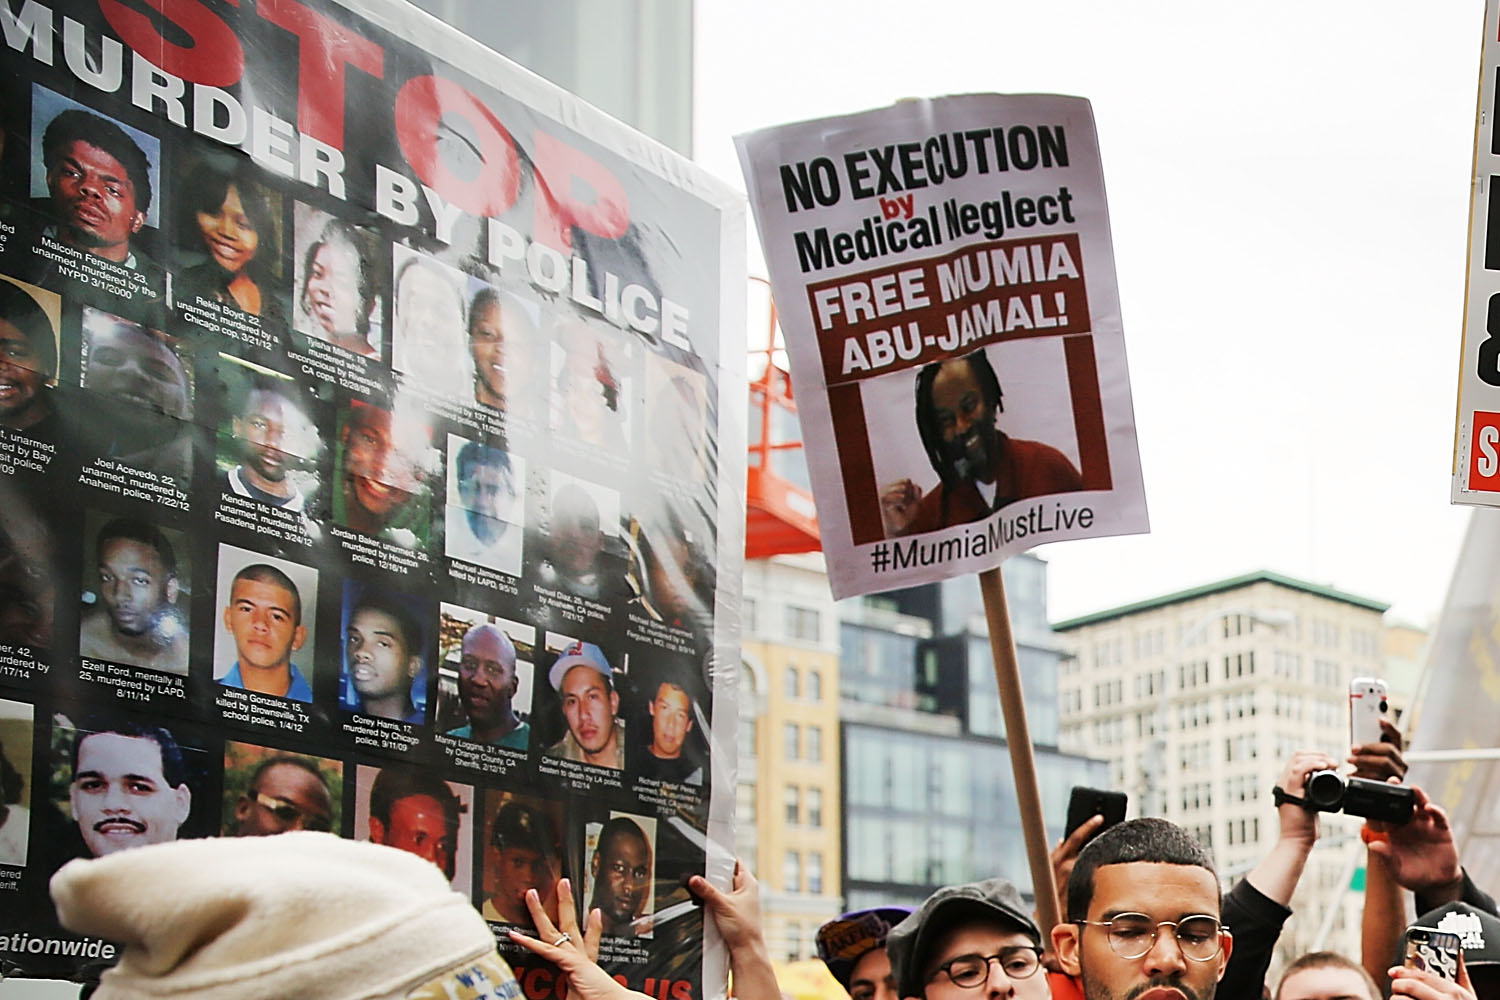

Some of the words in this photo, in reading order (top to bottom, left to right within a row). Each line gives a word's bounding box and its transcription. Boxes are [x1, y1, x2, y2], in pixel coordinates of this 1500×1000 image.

[100, 0, 629, 255] STOP
[0, 0, 346, 200] MURDER
[376, 164, 452, 245] BY
[488, 217, 691, 351] POLICE
[780, 157, 841, 212] NO
[844, 124, 1070, 201] EXECUTION
[879, 194, 915, 221] by
[794, 206, 942, 272] Medical
[947, 187, 1075, 241] Neglect
[42, 237, 83, 259] Malcolm
[59, 265, 89, 283] NYPD
[91, 277, 132, 299] 3/1/2000
[82, 264, 126, 287] murdered
[128, 283, 139, 294] by
[142, 286, 156, 298] the
[815, 268, 930, 330] FREE
[937, 242, 1079, 302] MUMIA
[842, 293, 1068, 375] ABU-JAMAL!
[17, 446, 30, 458] by
[32, 450, 51, 464] Bay
[94, 458, 114, 470] Joel
[78, 475, 120, 494] Anaheim
[156, 495, 190, 512] 7/22/12
[130, 479, 174, 497] murdered
[176, 490, 188, 501] by
[871, 502, 1094, 573] #MumiaMustLive
[38, 663, 50, 674] by
[82, 660, 104, 672] Ezell
[135, 671, 173, 687] mentally
[97, 674, 142, 689] murdered
[144, 683, 155, 694] by
[116, 690, 150, 702] 8/11/14
[223, 688, 247, 701] Jaime
[216, 698, 236, 710] killed
[239, 701, 249, 712] by
[299, 714, 310, 723] TX
[223, 710, 250, 723] school
[280, 720, 303, 732] 1/4/12
[0, 932, 115, 960] ationwide
